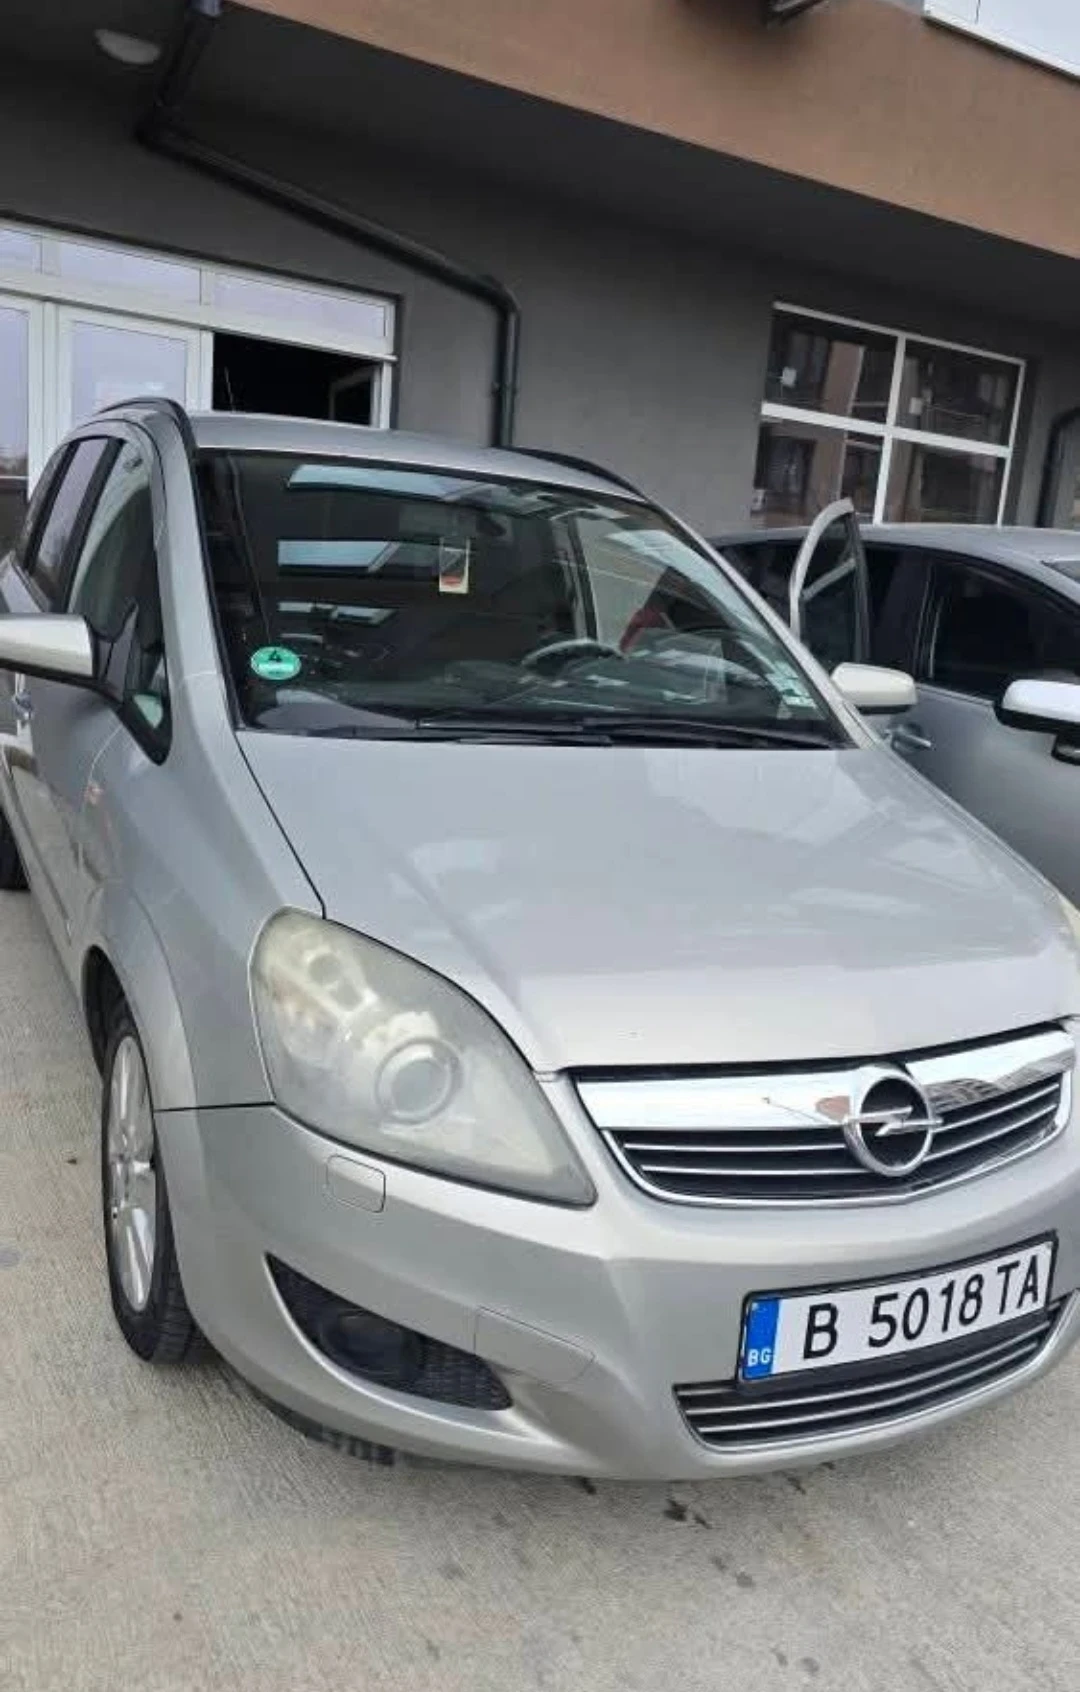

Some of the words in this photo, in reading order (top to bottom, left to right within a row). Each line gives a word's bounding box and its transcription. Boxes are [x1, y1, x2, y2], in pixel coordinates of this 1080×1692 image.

[803, 1302, 838, 1360] B
[868, 1273, 984, 1349] 5018
[997, 1255, 1039, 1315] TA
[749, 1349, 771, 1366] BG
